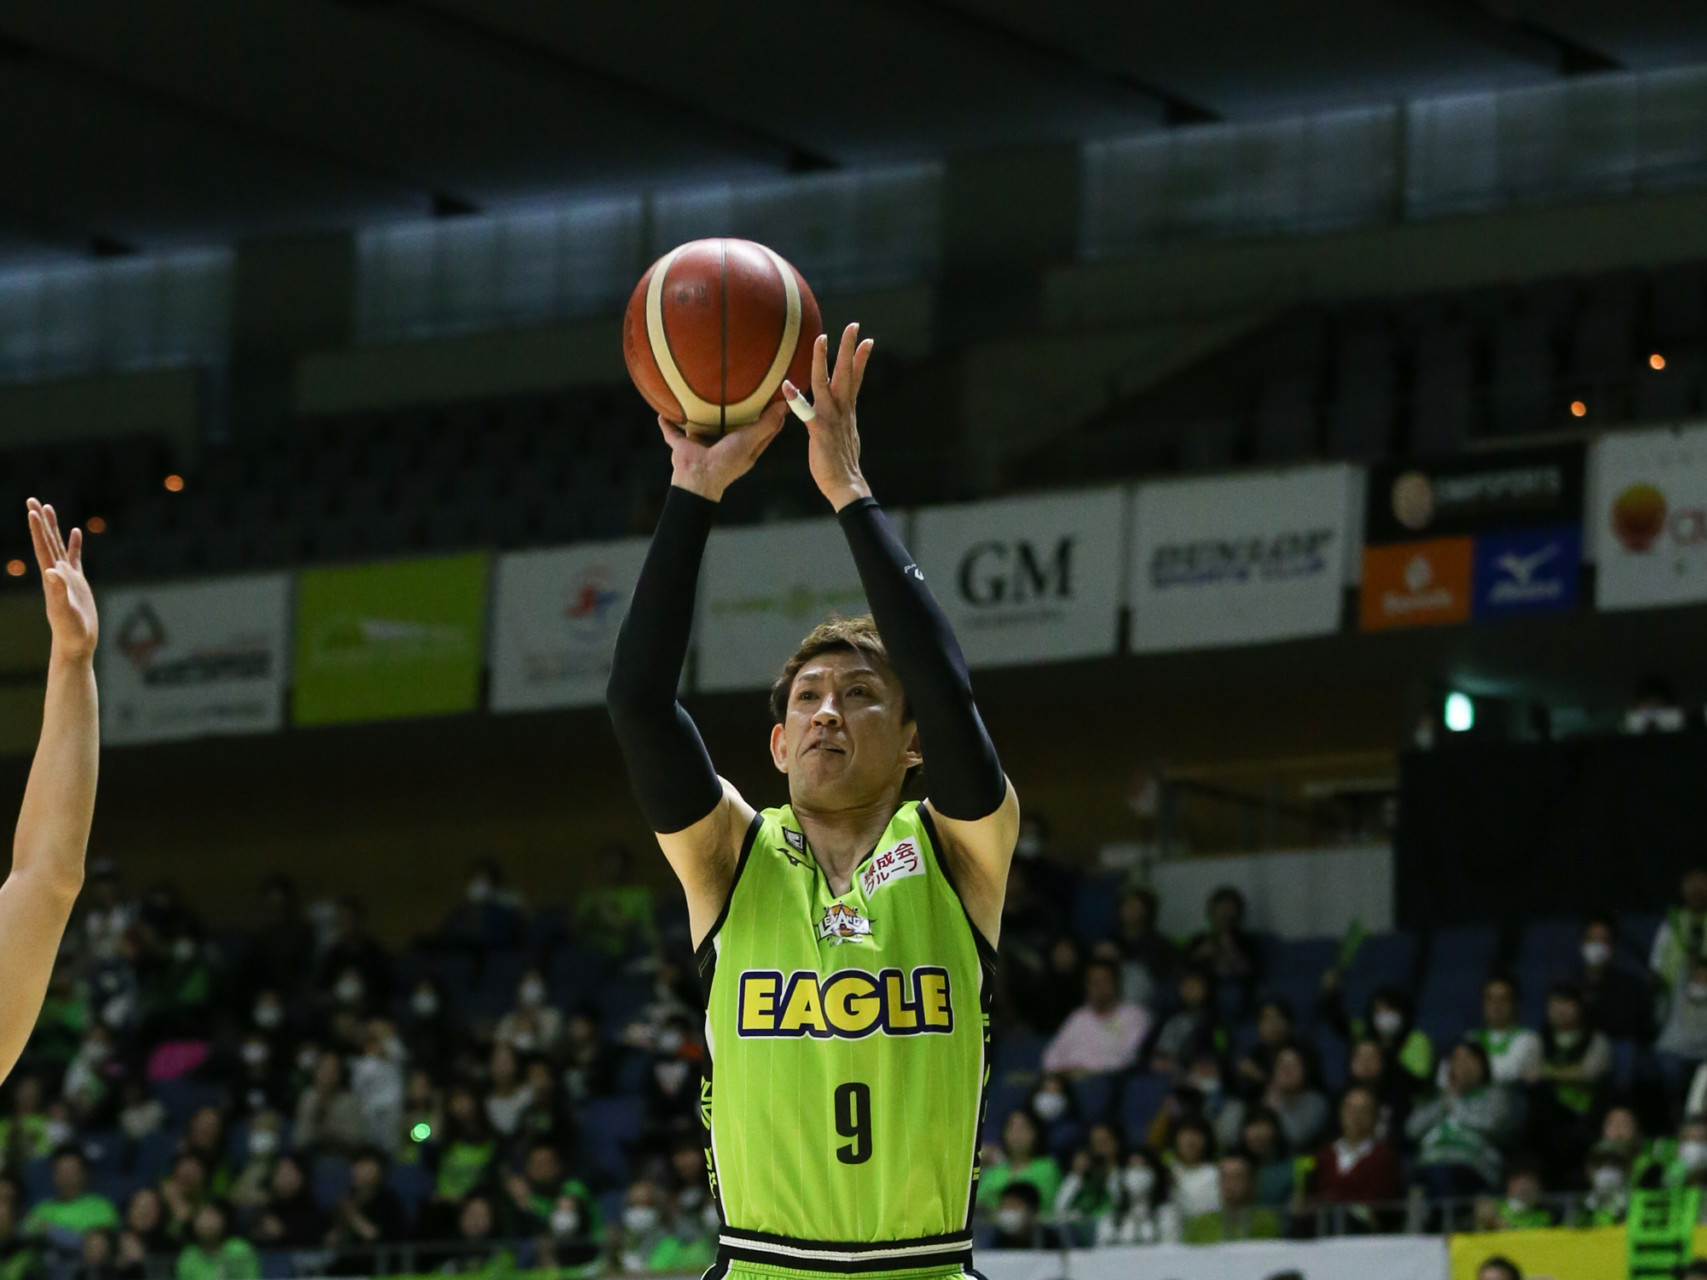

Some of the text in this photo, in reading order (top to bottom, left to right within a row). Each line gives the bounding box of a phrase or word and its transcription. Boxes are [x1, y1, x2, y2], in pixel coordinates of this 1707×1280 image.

[956, 537, 1075, 607] GM
[865, 856, 919, 896] グループ
[818, 907, 872, 940] LEVANG
[738, 966, 954, 1039] EAGLE
[834, 1082, 873, 1165] 9
